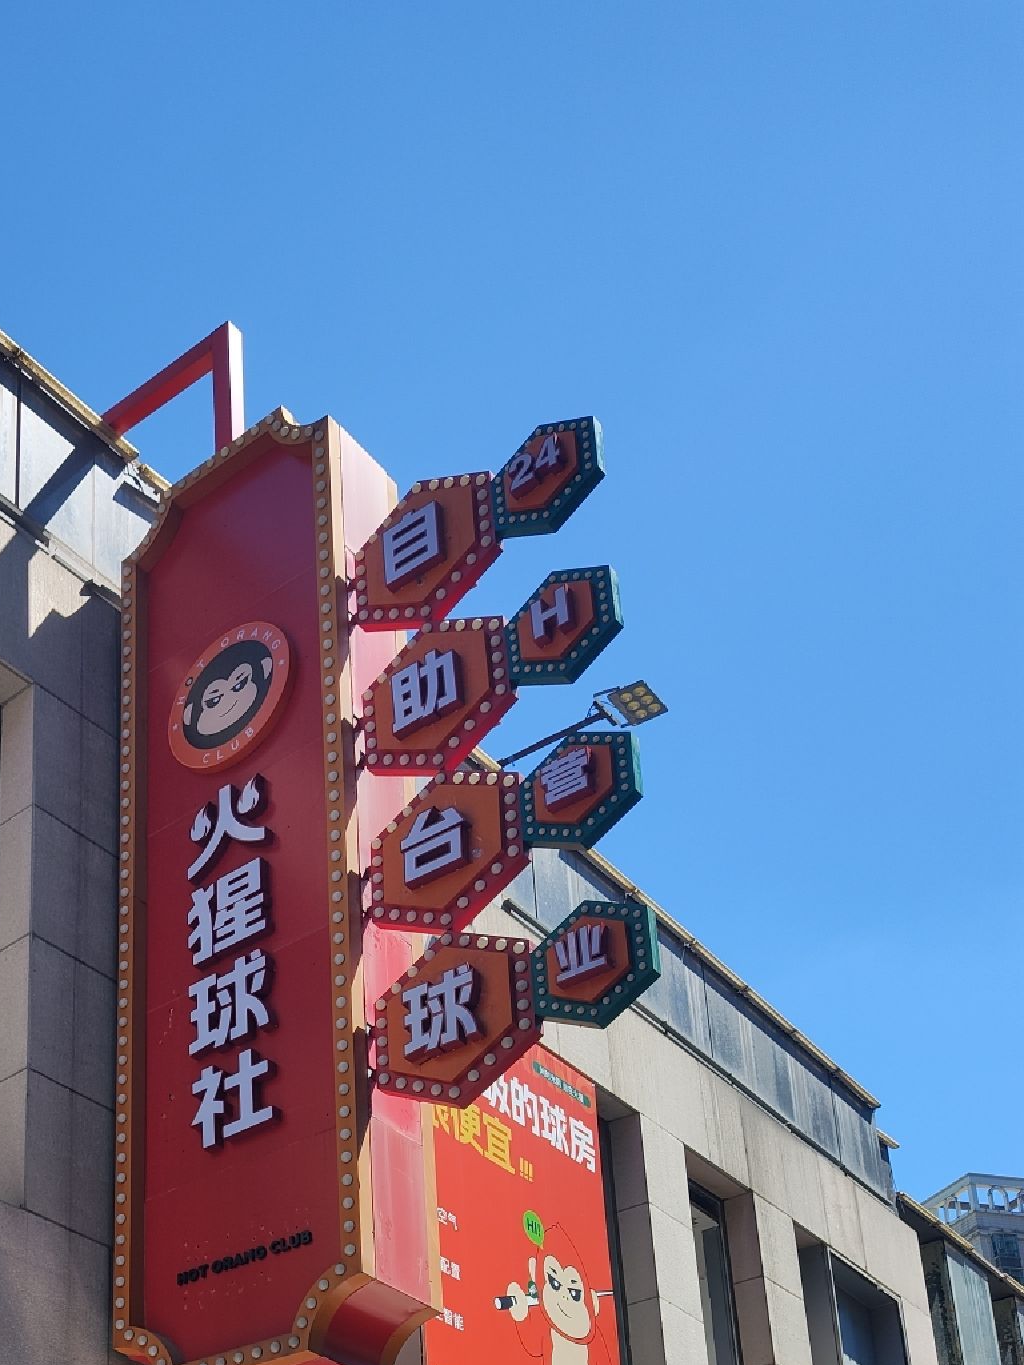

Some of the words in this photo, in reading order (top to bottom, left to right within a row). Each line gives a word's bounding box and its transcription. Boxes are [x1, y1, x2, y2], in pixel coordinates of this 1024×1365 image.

[221, 627, 281, 650] ORANG
[202, 727, 254, 763] CLUB
[187, 773, 273, 1149] 火猩球社
[177, 1263, 210, 1286] HOT
[211, 1245, 268, 1274] ORANG
[269, 1229, 313, 1255] CLUB
